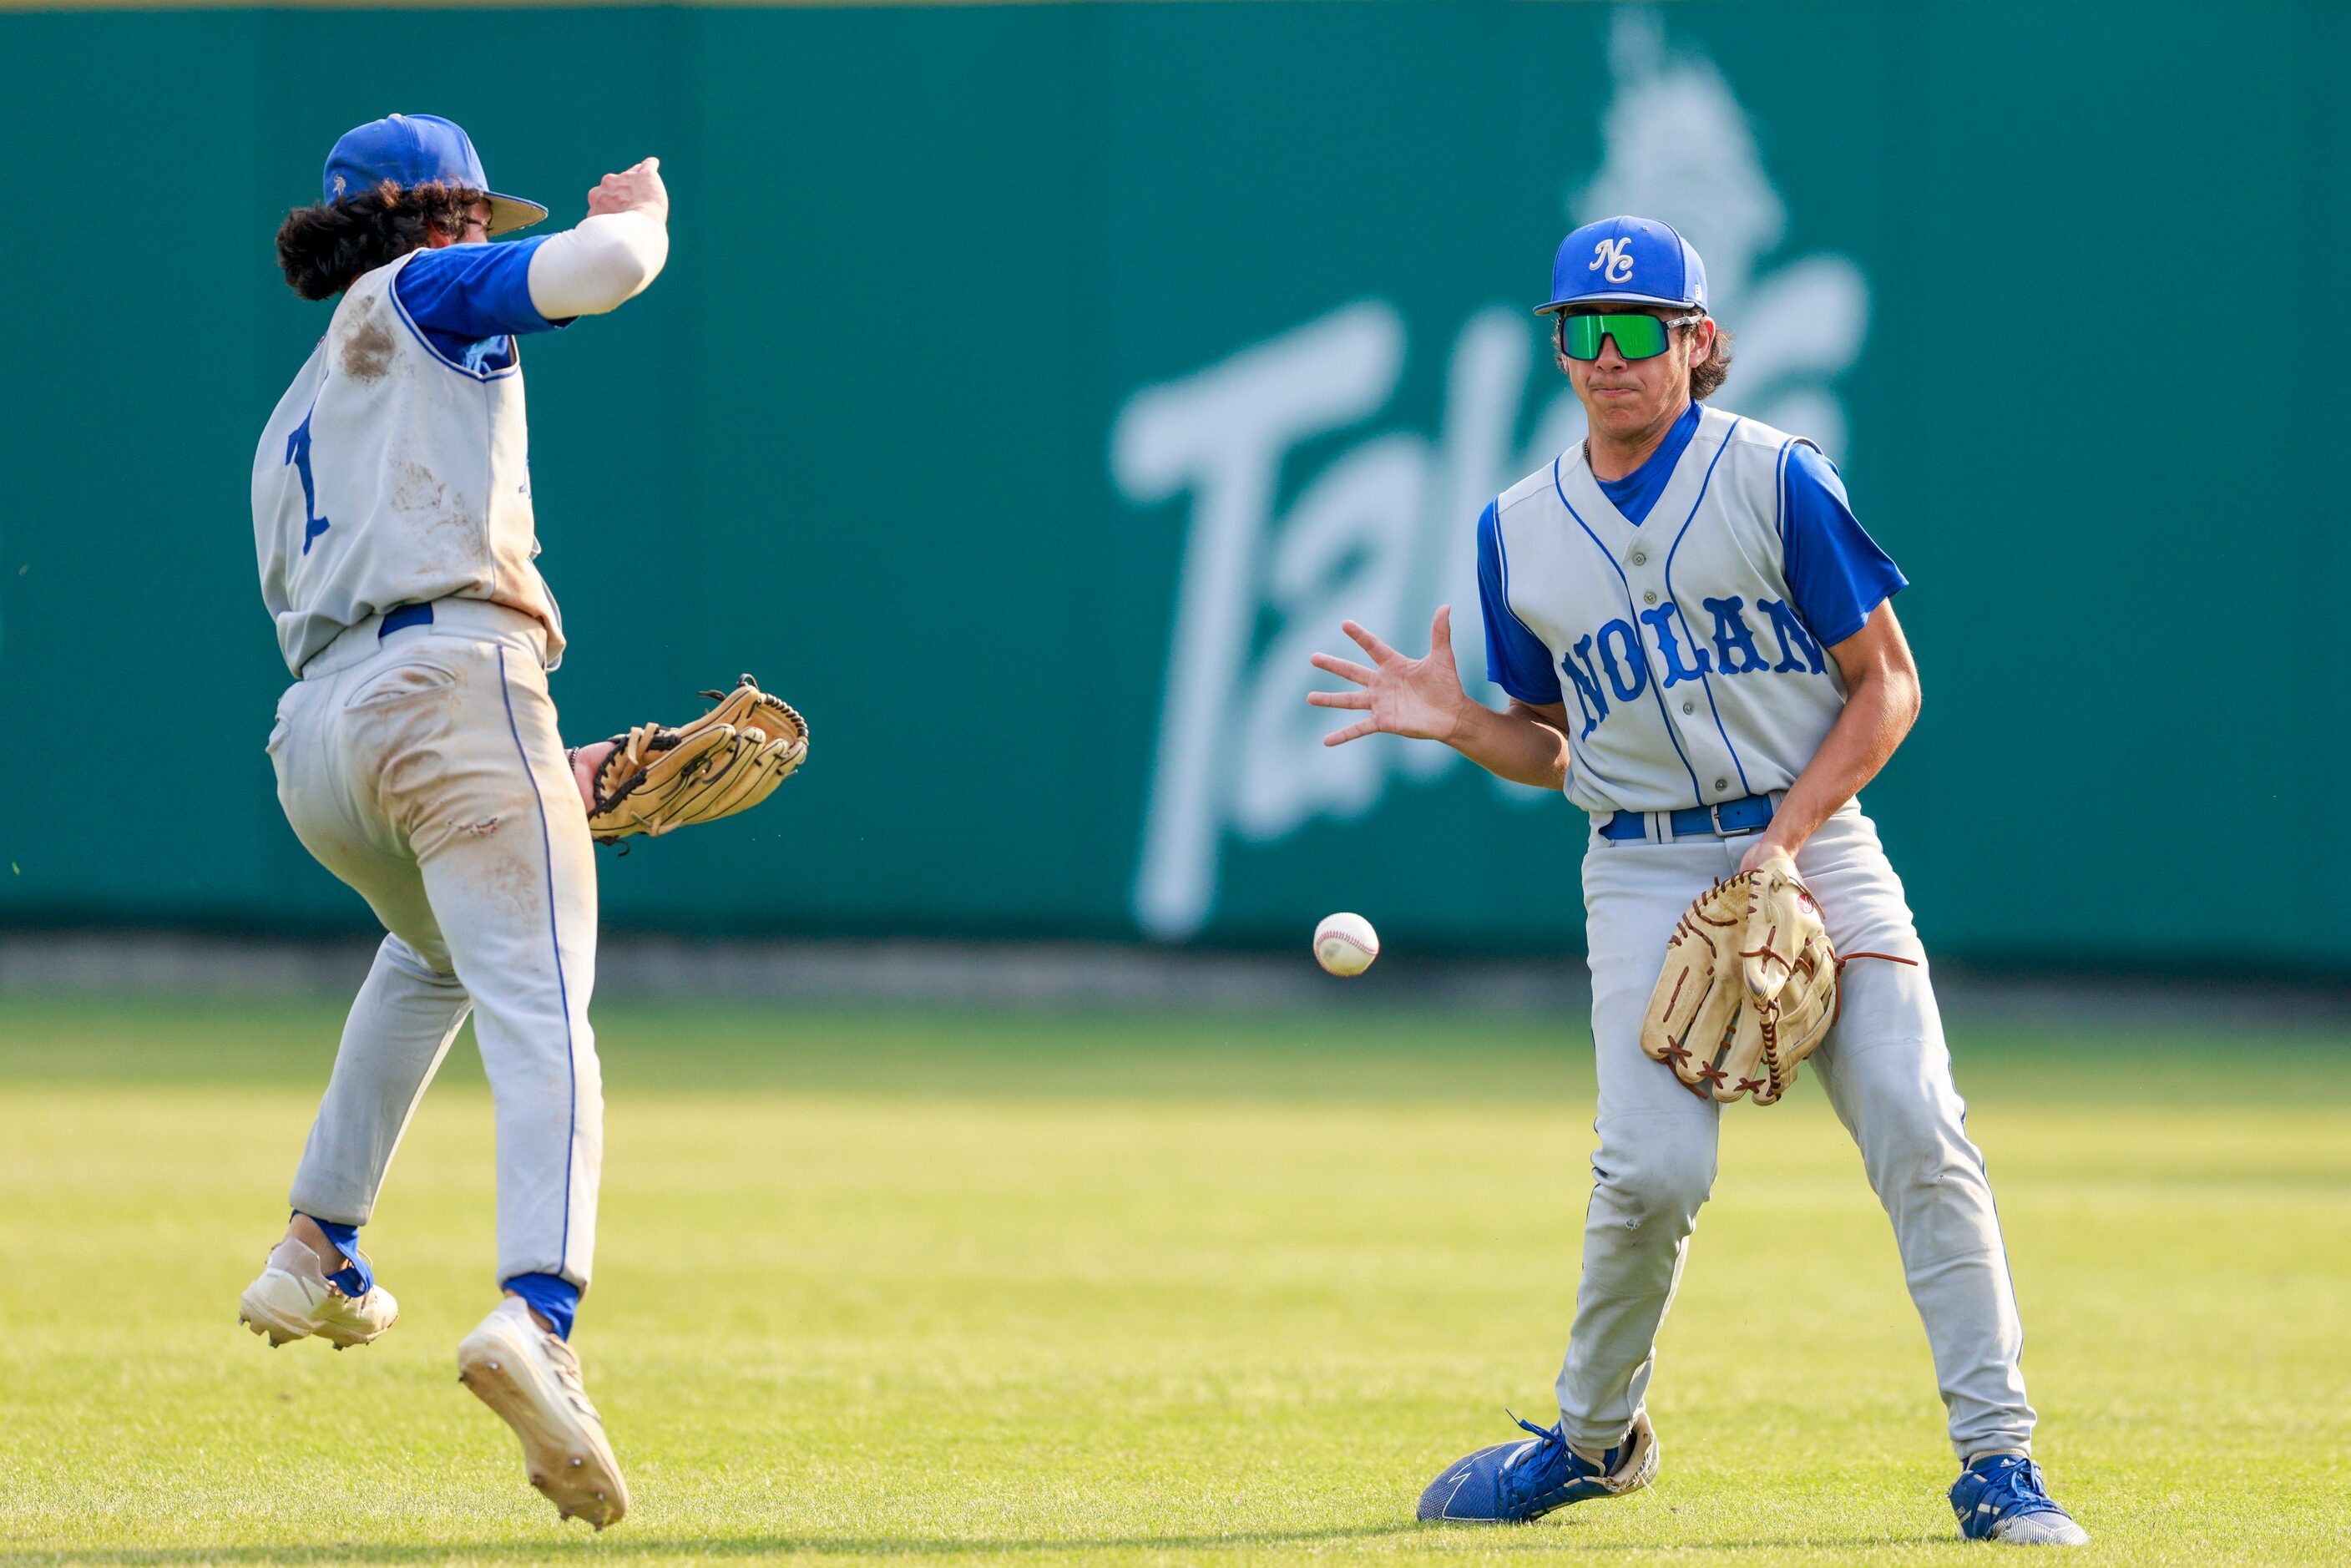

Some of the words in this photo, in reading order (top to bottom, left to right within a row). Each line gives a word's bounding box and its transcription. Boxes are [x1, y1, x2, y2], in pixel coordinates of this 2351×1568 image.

[1589, 237, 1634, 284] NC
[285, 371, 331, 557] 1
[1561, 595, 1828, 743] NOLAN
